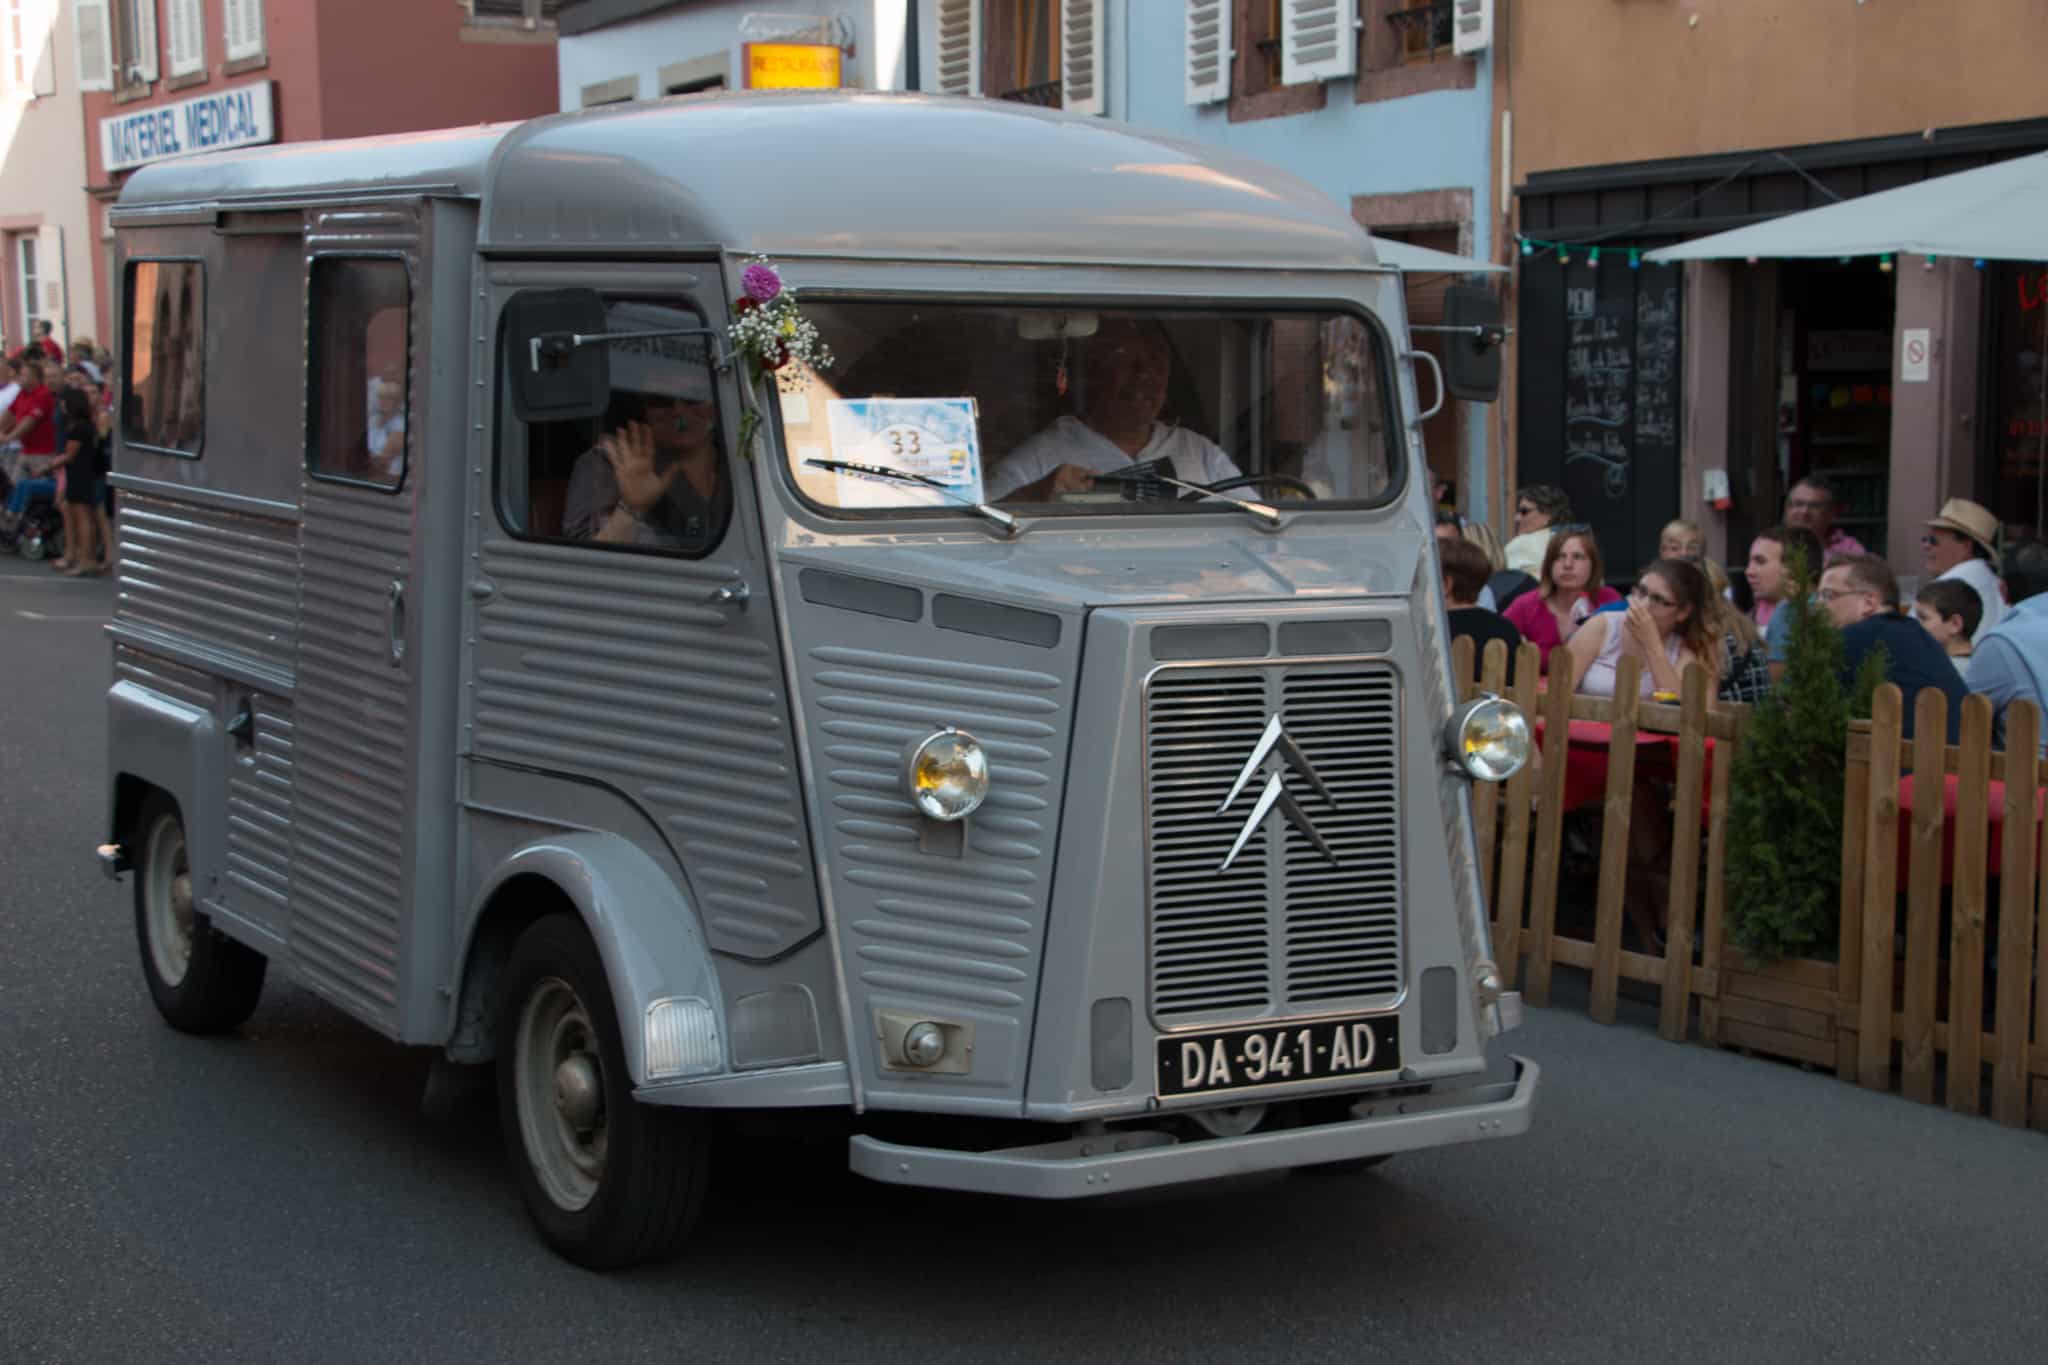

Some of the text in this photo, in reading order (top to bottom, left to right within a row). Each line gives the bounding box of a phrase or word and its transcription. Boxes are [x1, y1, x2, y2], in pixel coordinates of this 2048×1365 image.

[110, 91, 258, 163] MATERIEL MEDICAL
[889, 431, 921, 455] 33
[1181, 1023, 1376, 1089] DA-941-AD
